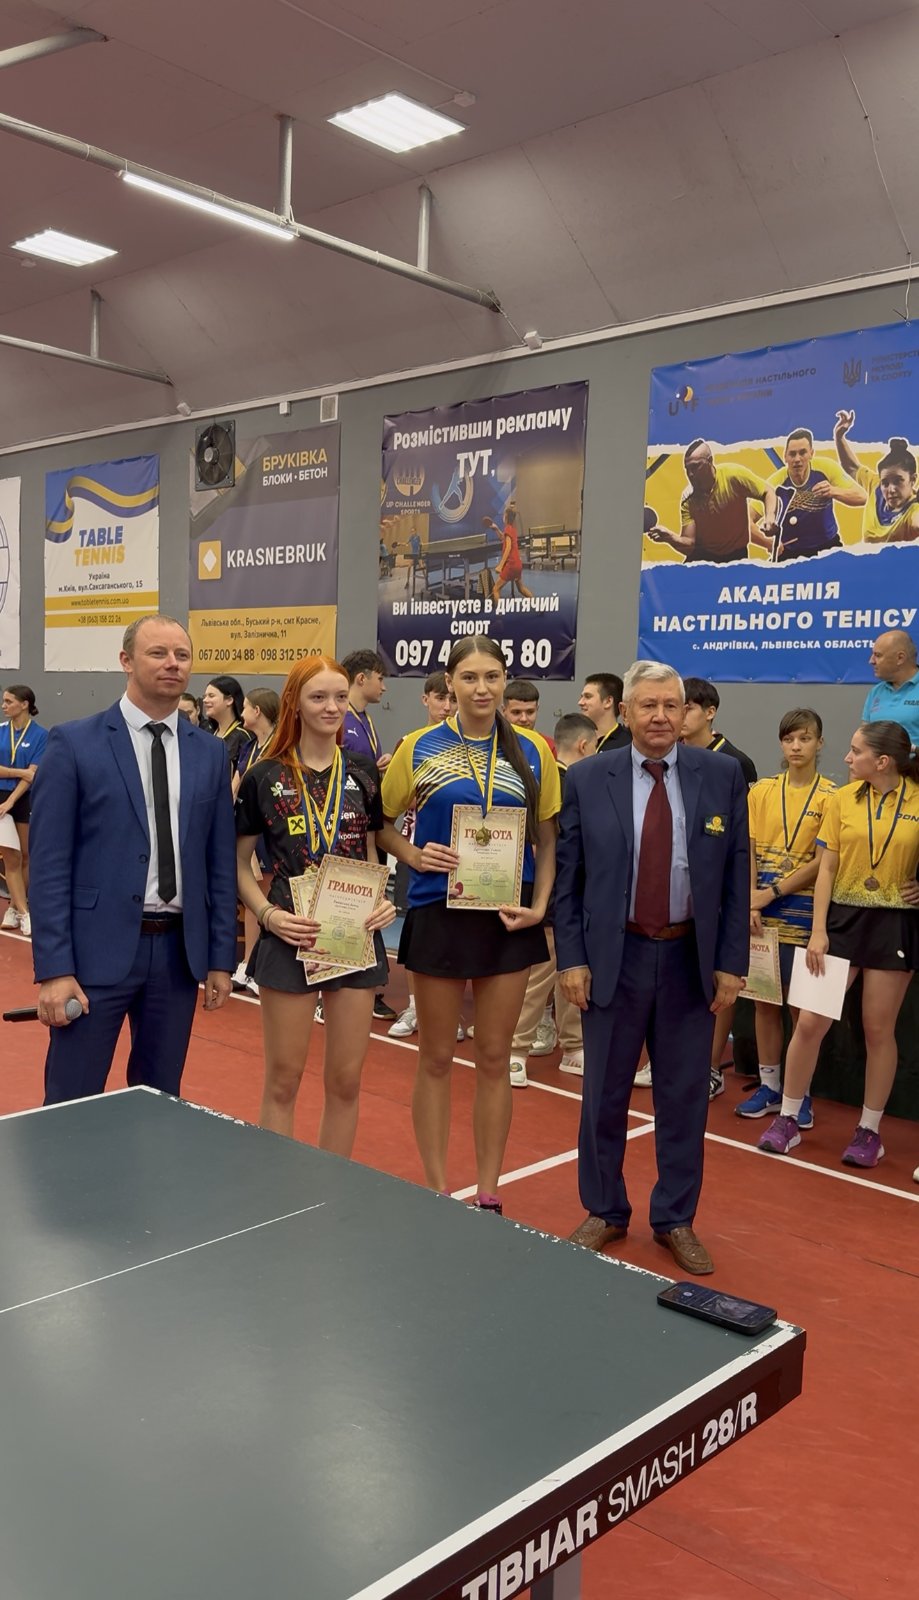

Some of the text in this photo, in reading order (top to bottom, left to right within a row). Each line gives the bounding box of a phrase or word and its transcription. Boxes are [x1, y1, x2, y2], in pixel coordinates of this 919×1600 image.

[755, 367, 816, 385] НАСТІЛЬНОГО
[393, 406, 573, 451] Розмістивши рекламу
[262, 448, 328, 472] БРУКІВКА
[262, 467, 328, 487] БЛОКИ БЕТОН
[79, 525, 124, 548] TABLE
[74, 544, 126, 567] TENNIS
[226, 542, 327, 569] KRASNEBRUK
[88, 572, 110, 582] Україна
[136, 580, 143, 588] 15
[717, 581, 841, 605] АКАДЕМІЯ
[392, 592, 560, 618] ви інвестуєте в дитячий
[201, 618, 229, 627] Львівська
[245, 617, 270, 627] Буський
[450, 619, 491, 636] спорт
[653, 608, 918, 632] НАСТІЛЬНОГО ТЕНІСУ
[281, 630, 287, 638] 11
[198, 649, 213, 661] 067
[214, 648, 230, 661] 200
[232, 648, 242, 661] 34
[244, 648, 255, 660] 88
[260, 648, 277, 660] 098
[280, 648, 295, 661] 312
[395, 639, 434, 667] 097
[520, 638, 552, 668] 80
[702, 640, 759, 651] АНДРІЇВКА,
[761, 639, 821, 650] ЛЬВІВСЬКА
[463, 828, 513, 840] ГРОТА
[327, 879, 373, 898] ГРАМОТА
[750, 943, 770, 953] МОТА
[461, 1391, 758, 1600] TIBHAR SMASH 28/R
